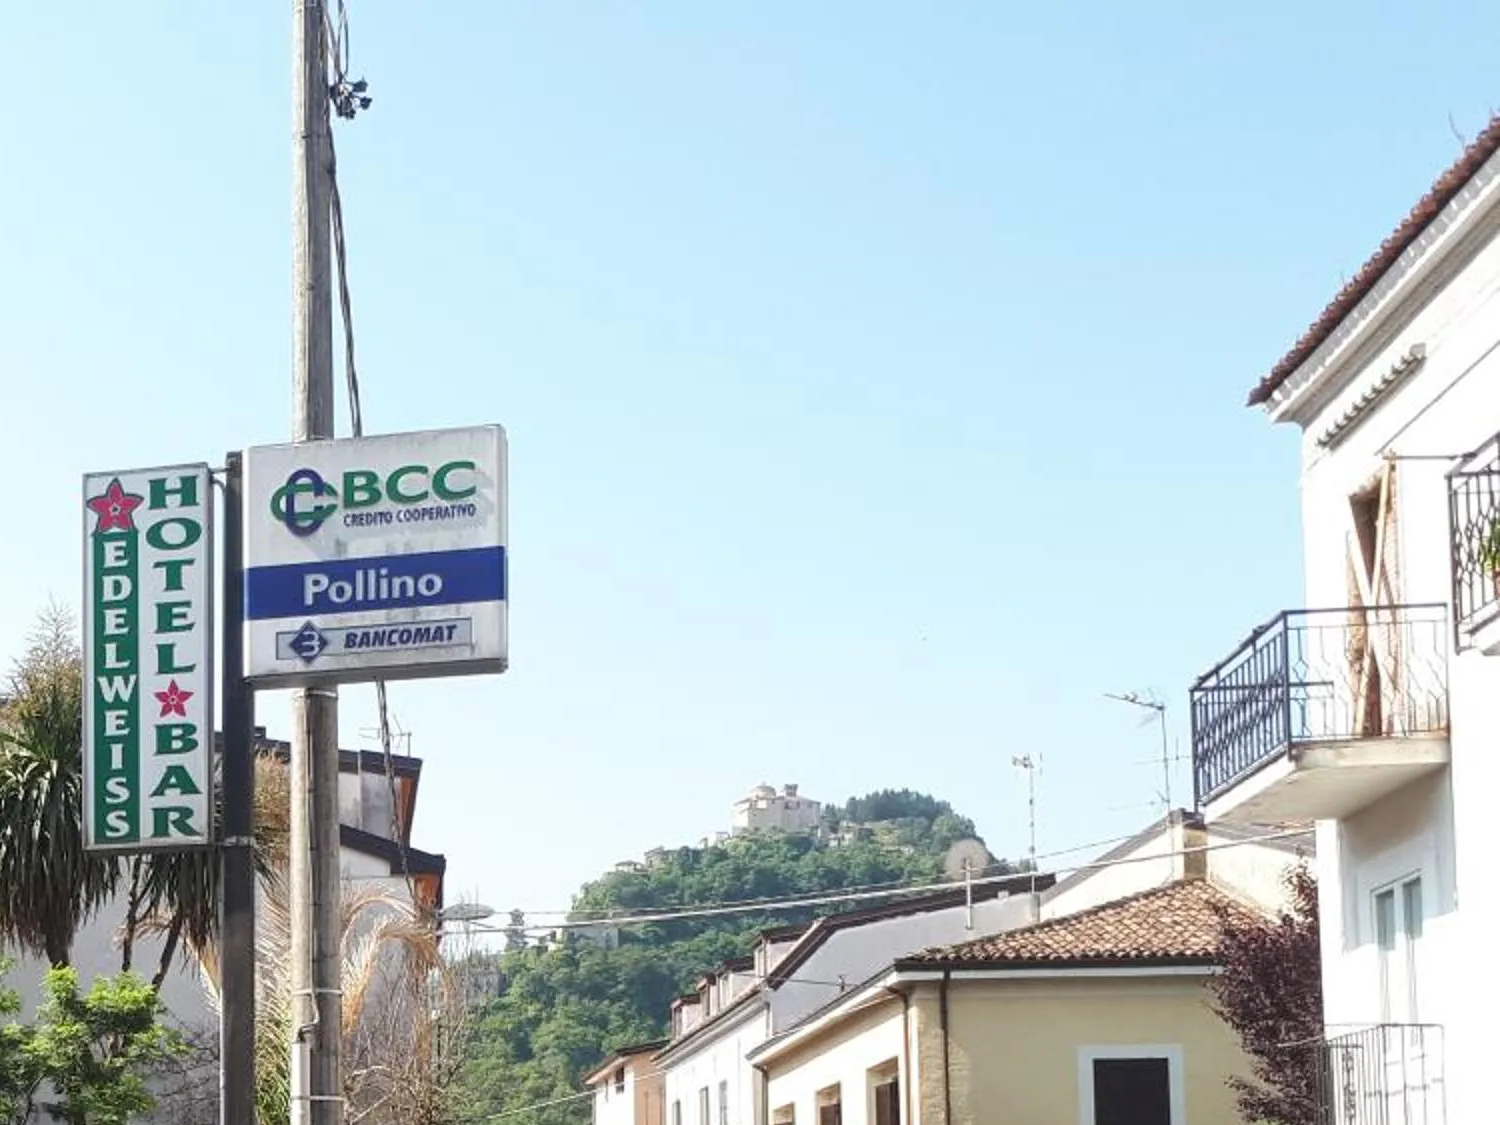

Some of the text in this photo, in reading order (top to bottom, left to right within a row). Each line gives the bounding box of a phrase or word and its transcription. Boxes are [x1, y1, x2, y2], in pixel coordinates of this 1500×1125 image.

[342, 460, 477, 508] BCC
[343, 503, 477, 528] CREDITO COOPERATIVO
[303, 567, 443, 606] Pollino
[145, 474, 202, 838] HOTEL BAR
[344, 624, 457, 649] BANCOMAT
[98, 540, 137, 839] EDELWEISS
